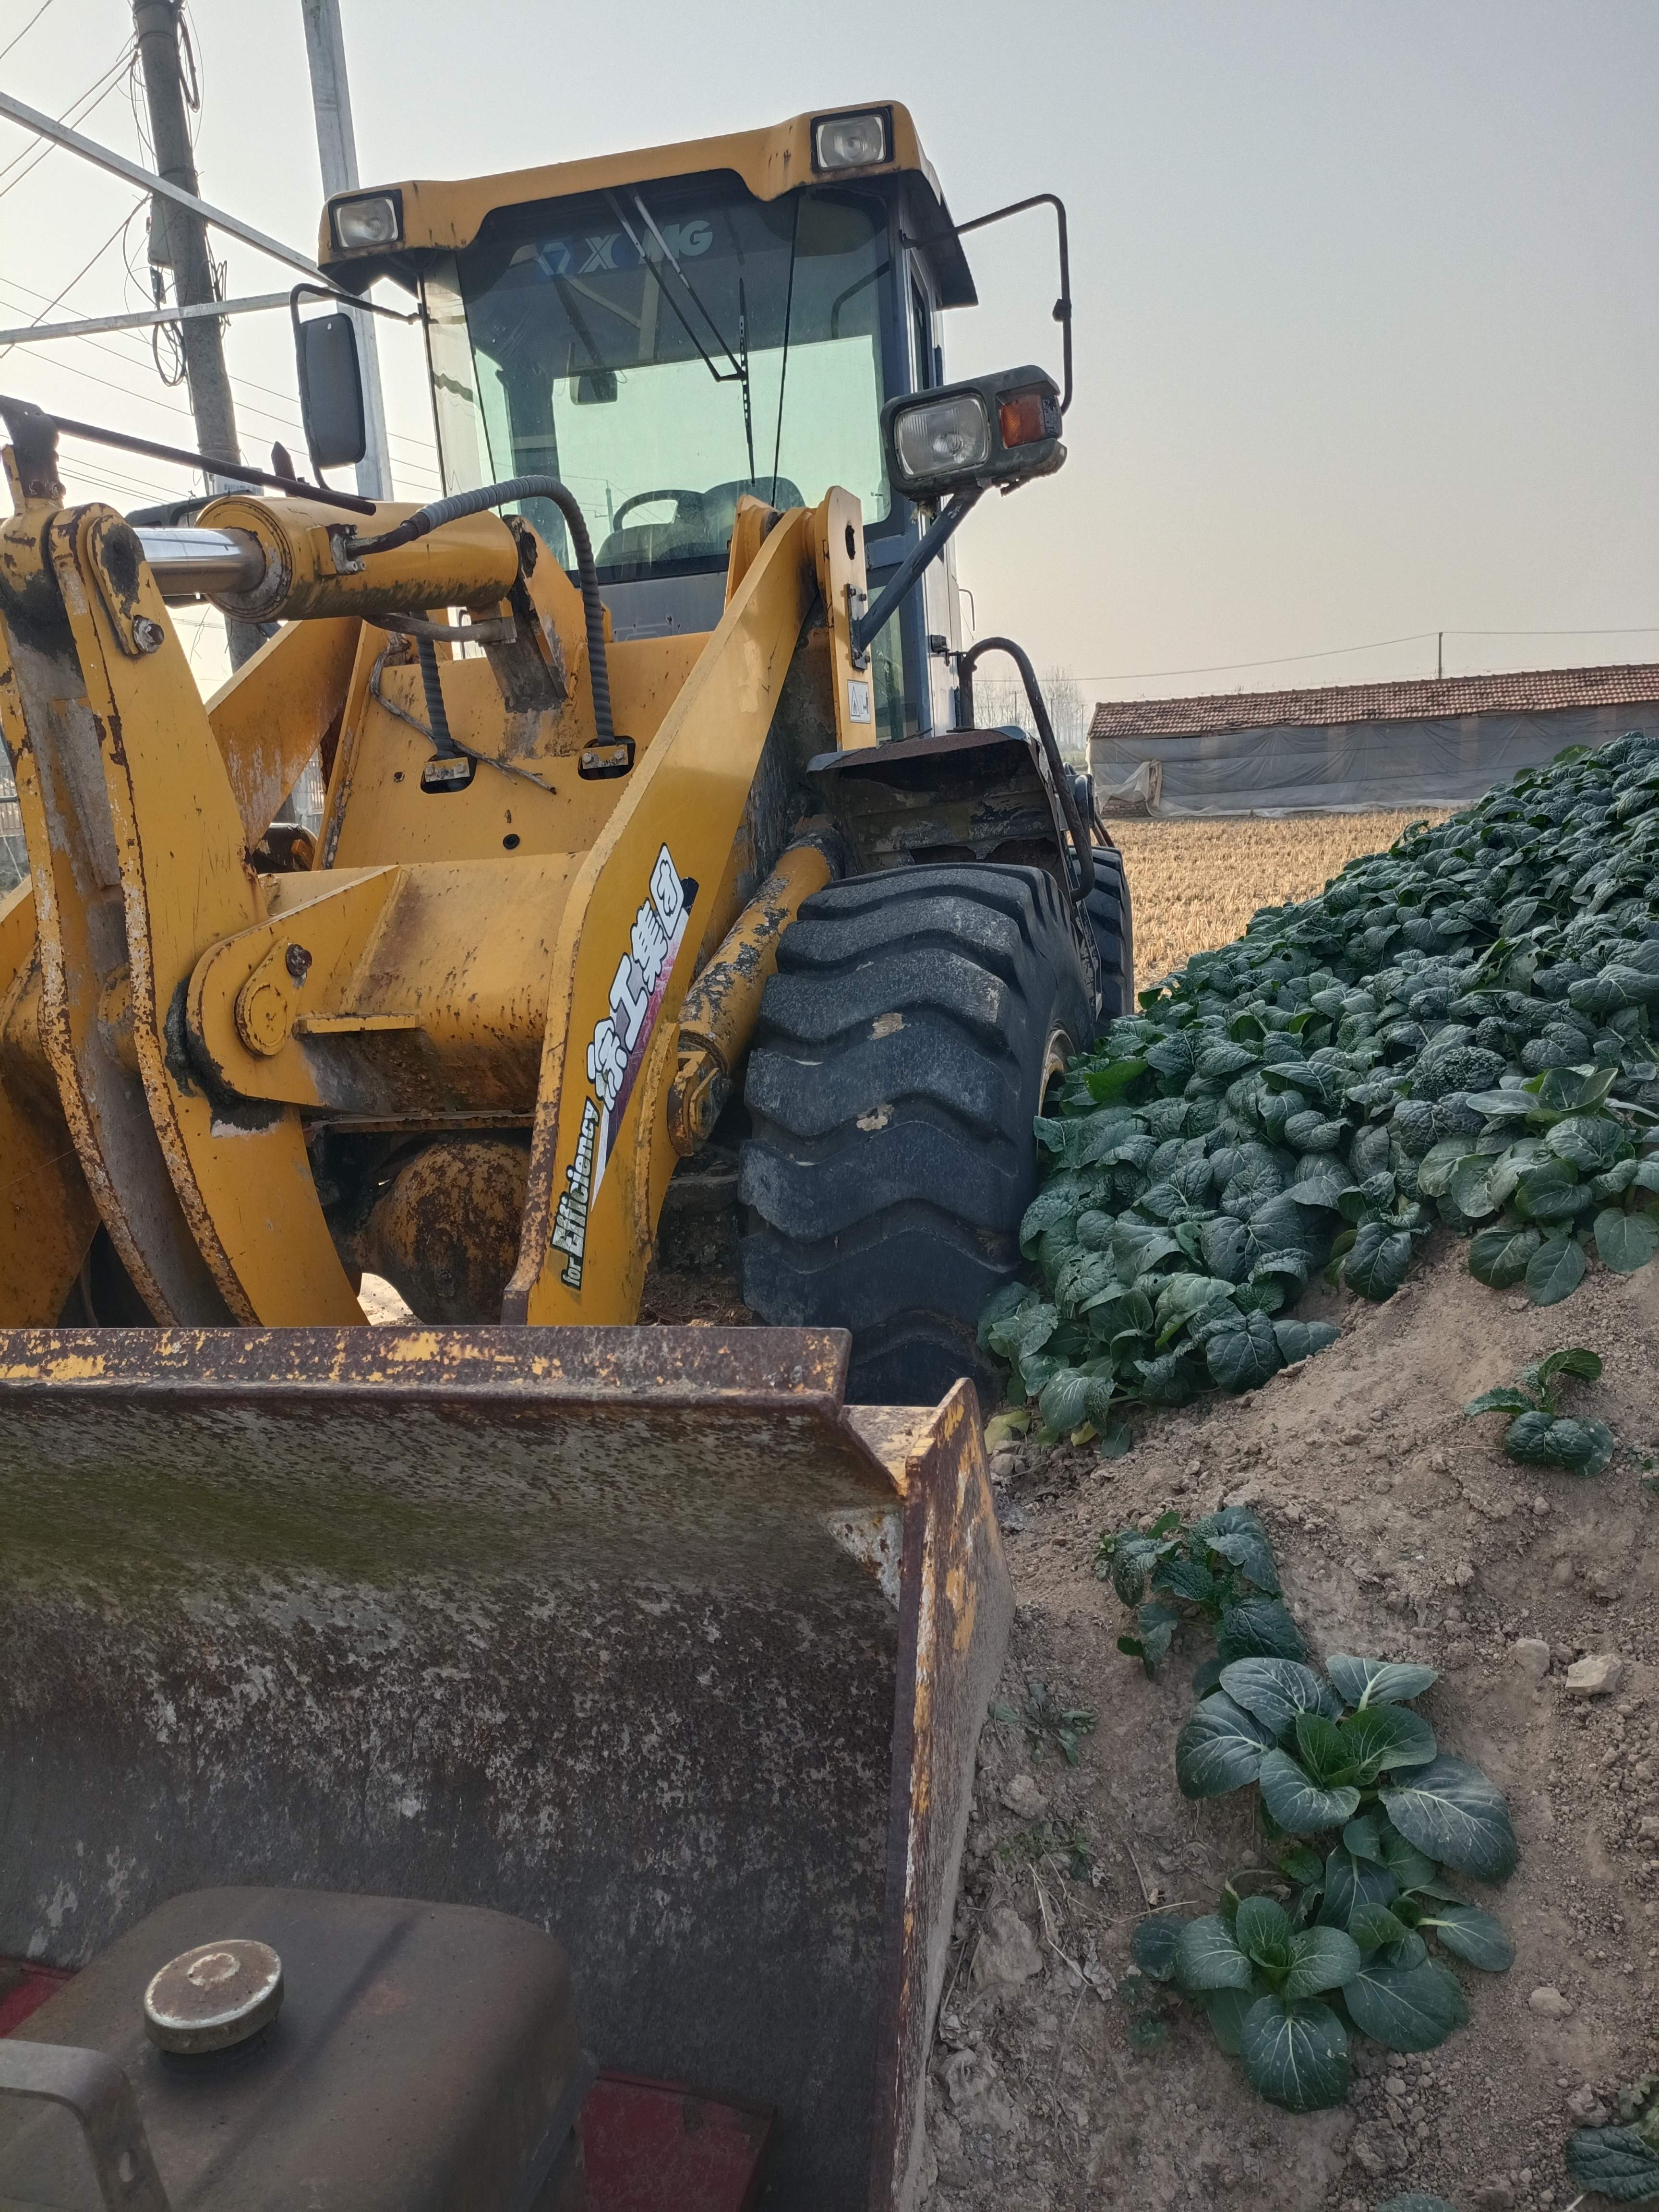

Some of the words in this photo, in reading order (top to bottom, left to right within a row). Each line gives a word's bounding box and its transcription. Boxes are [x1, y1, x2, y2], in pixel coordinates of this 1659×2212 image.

[587, 843, 684, 1112] 徐工集团
[551, 1099, 598, 1258] Efficiency
[563, 1257, 581, 1286] for
